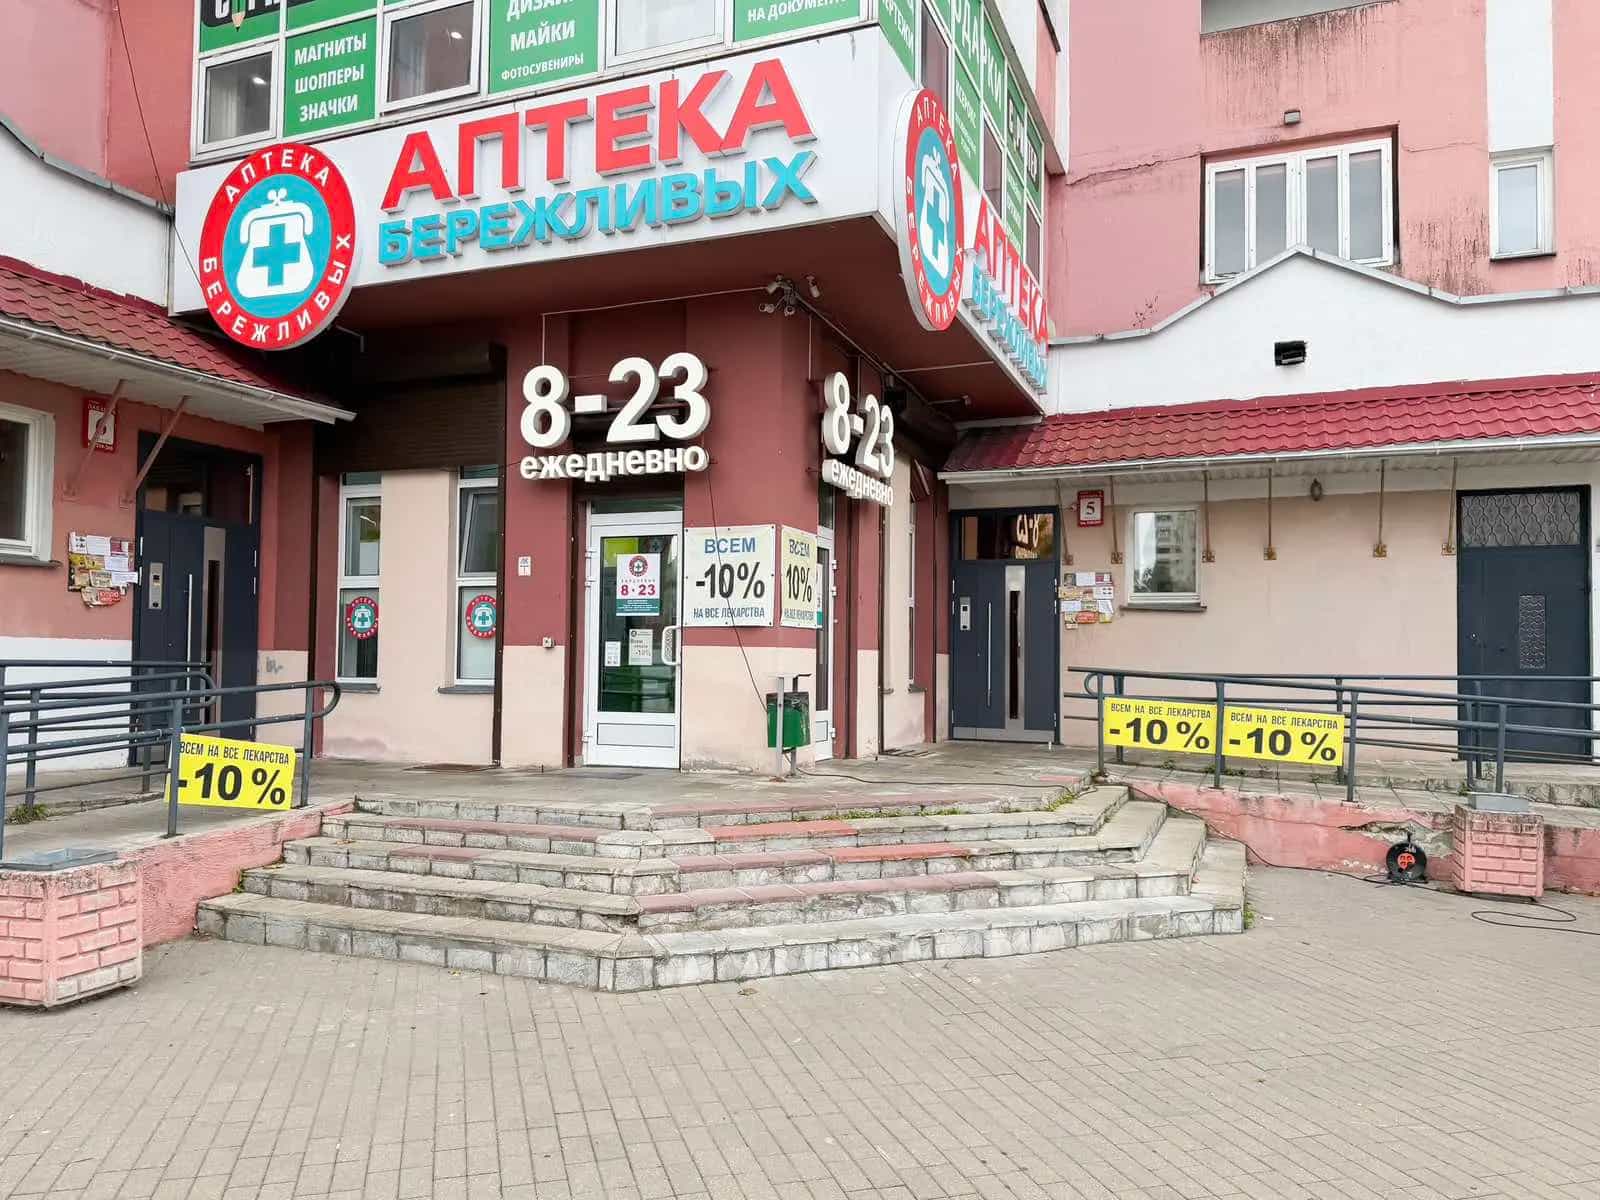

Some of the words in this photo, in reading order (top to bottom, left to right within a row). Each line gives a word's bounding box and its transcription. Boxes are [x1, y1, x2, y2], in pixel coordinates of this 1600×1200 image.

[747, 7, 766, 23] НА
[294, 32, 367, 67] МАГНИТЫ
[511, 19, 576, 52] МАЙКИ
[295, 63, 365, 95] ШОППЕРЫ
[501, 51, 584, 81] ФОТОСУВЕНИРЫ
[299, 94, 359, 122] ЗНАЧКИ
[379, 57, 818, 213] АПТЕКА
[916, 96, 959, 181] АПТЕКА
[225, 149, 330, 203] АПТЕКА
[378, 149, 819, 266] БЕРЕЖЛИВЫХ
[973, 194, 1049, 345] АПТЕКА
[203, 233, 351, 343] БЕРЕЖЛИВЫХ
[520, 352, 711, 448] 8-23
[824, 371, 895, 478] 8-23
[519, 446, 710, 482] ежедневно
[822, 458, 894, 507] ежедневно
[1086, 501, 1096, 515] 5
[704, 537, 756, 554] ВСЕМ
[789, 539, 810, 557] ВСЕМ
[695, 561, 765, 600] -10%
[786, 563, 812, 603] 10%
[693, 607, 703, 618] НА
[704, 607, 720, 618] ВСЕ
[721, 606, 766, 618] ЛЕКАРСТВА
[1111, 703, 1131, 713] ВСЕМ
[1135, 705, 1145, 714] НА
[1148, 706, 1162, 716] ВСЕ
[1167, 707, 1211, 719] ЛЕКАРСТВА
[1230, 712, 1252, 722] ВСЕМ
[1256, 714, 1267, 723] НА
[1271, 715, 1287, 725] ВСЕ
[1291, 717, 1338, 729] ЛЕКАРСТВА
[207, 745, 219, 757] НА
[223, 747, 239, 760] ВСЕ
[243, 748, 289, 765] ЛЕКАРСТВА
